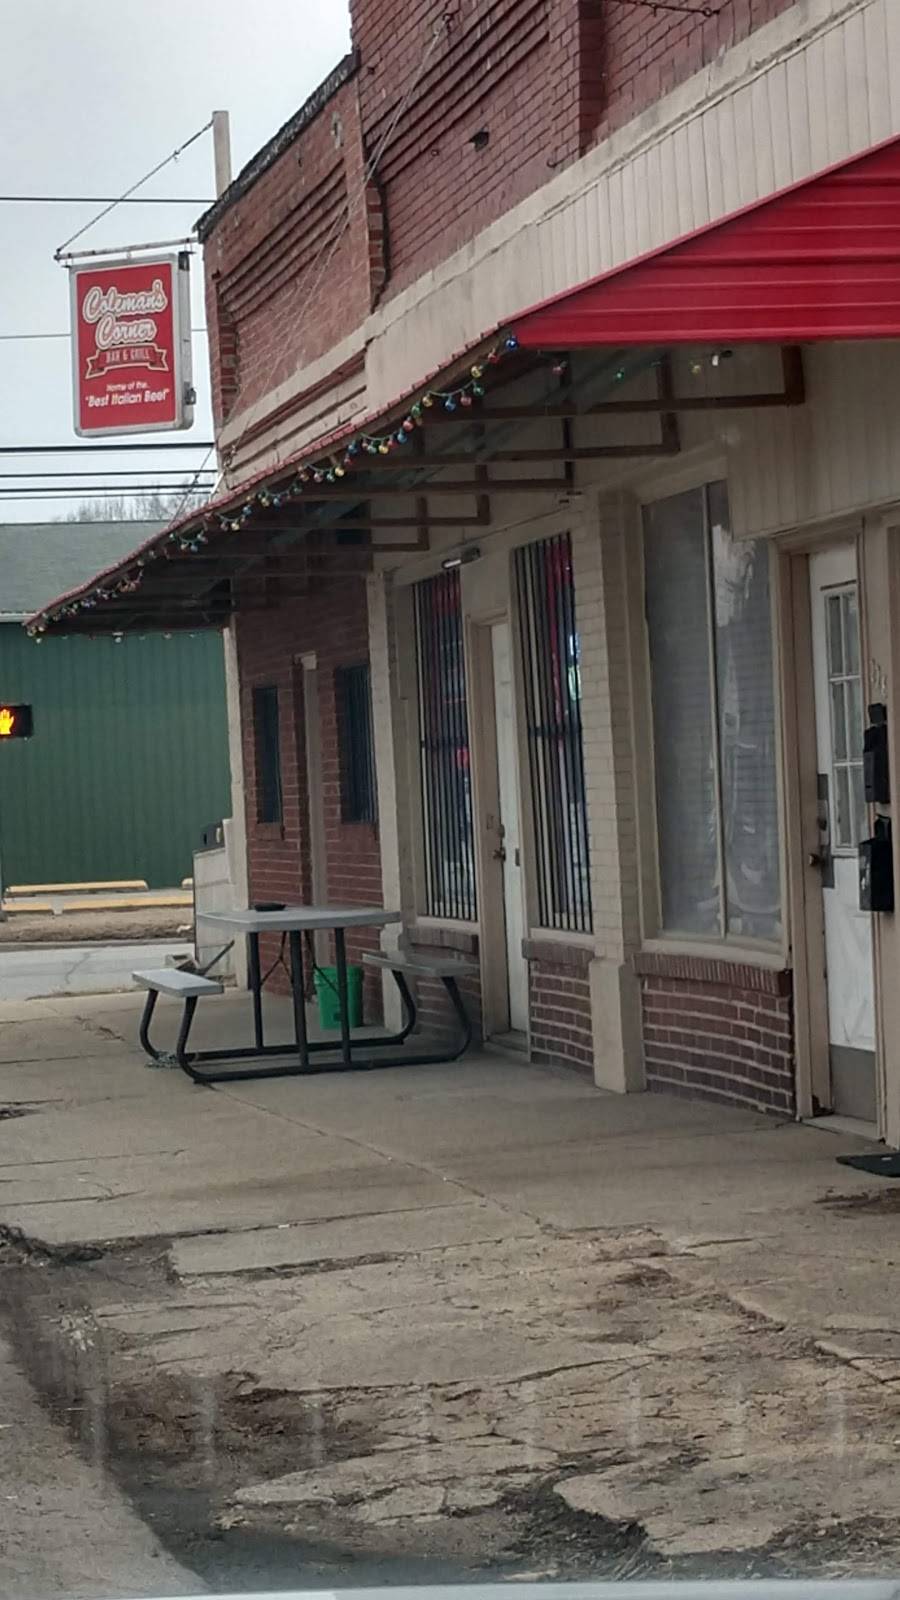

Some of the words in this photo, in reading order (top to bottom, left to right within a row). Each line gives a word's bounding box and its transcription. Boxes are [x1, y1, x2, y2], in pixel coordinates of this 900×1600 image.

[95, 313, 157, 350] Corner
[127, 381, 135, 390] of
[111, 392, 141, 405] Italian
